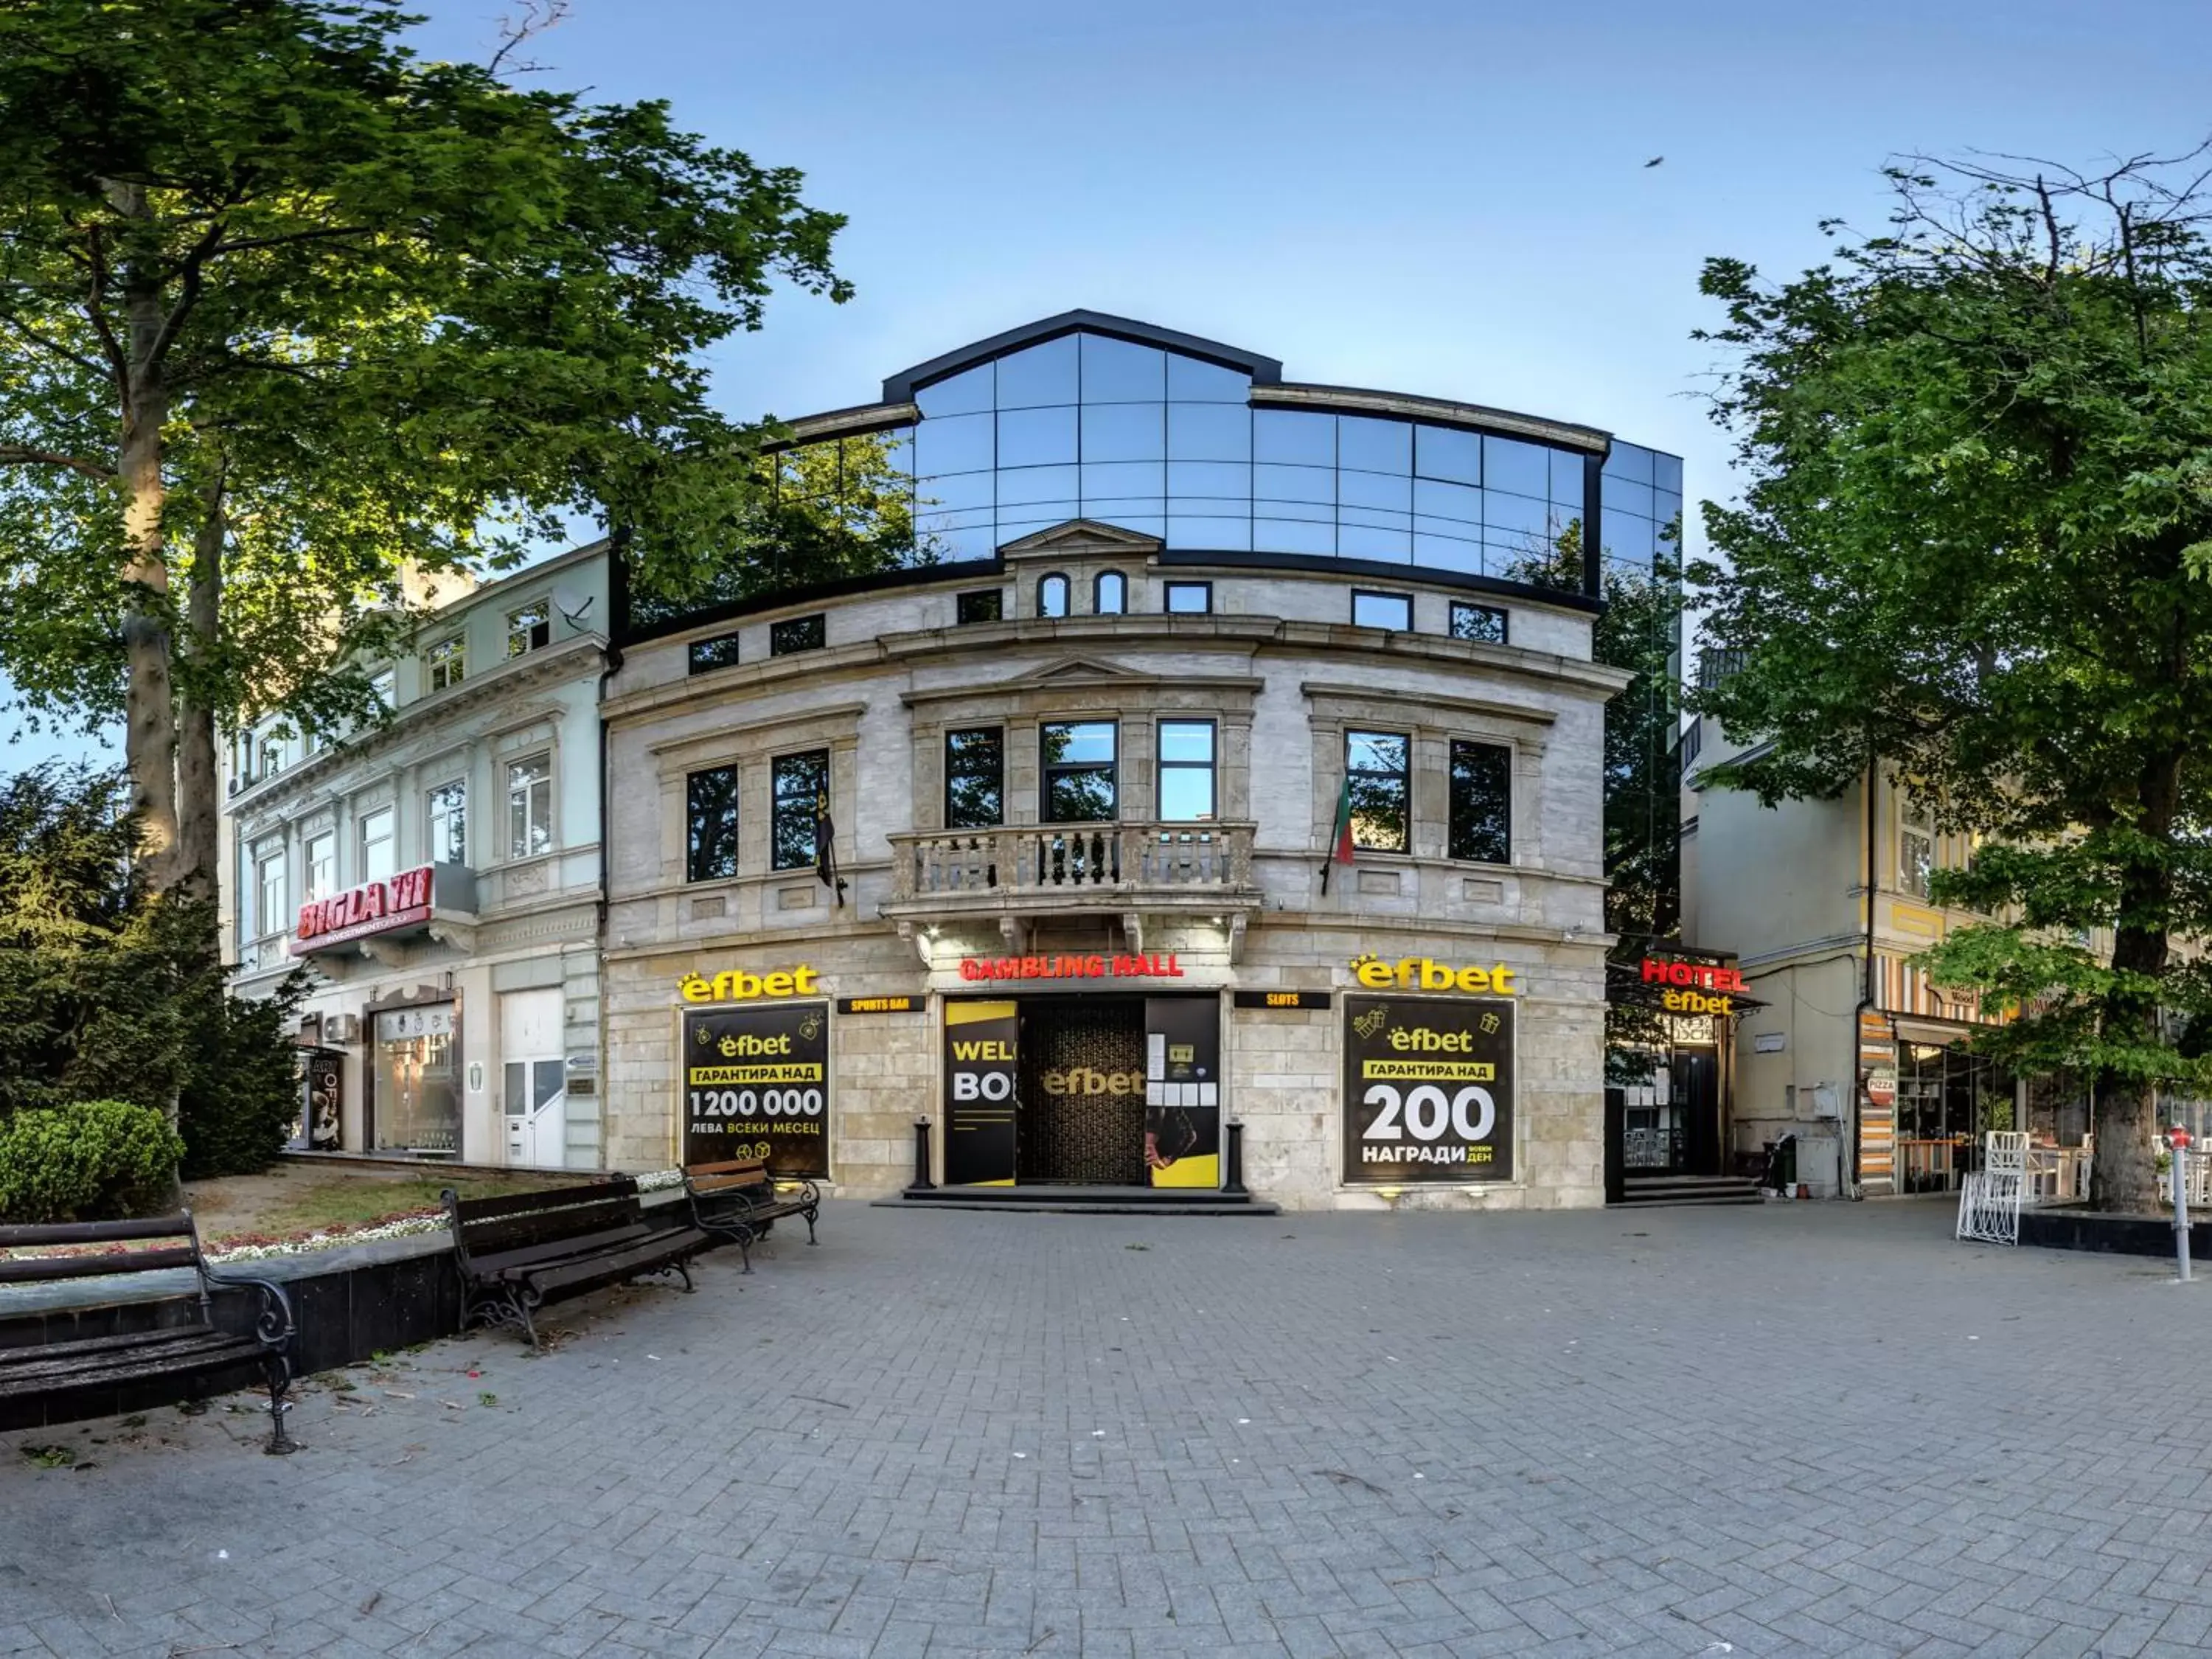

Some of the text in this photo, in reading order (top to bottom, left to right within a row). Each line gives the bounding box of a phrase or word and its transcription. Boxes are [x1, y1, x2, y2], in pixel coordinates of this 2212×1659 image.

[297, 883, 387, 939] BIGLA
[960, 952, 1184, 981] GAMBLING HALL
[1351, 953, 1515, 995] efbet
[1641, 958, 1750, 992] HOTEL
[678, 964, 818, 1004] efbet
[851, 998, 909, 1012] SPORTS BAR
[1266, 993, 1299, 1006] SLOTS
[717, 1033, 791, 1057] efbet
[1388, 1026, 1473, 1052] efbet
[696, 1067, 815, 1082] ГАРАНТИРА НАД
[1370, 1064, 1488, 1078] ГАРАНТИРА НАД
[953, 1071, 1017, 1101] BO
[1869, 1079, 1894, 1090] PIZZA
[762, 1088, 823, 1116] 000
[1362, 1085, 1495, 1141] 200
[691, 1121, 820, 1135] ЛЕВА ВСЕКИ МЕСЕЦ
[1362, 1146, 1466, 1164] НАГРАДИ
[1467, 1152, 1492, 1163] ДЕН
